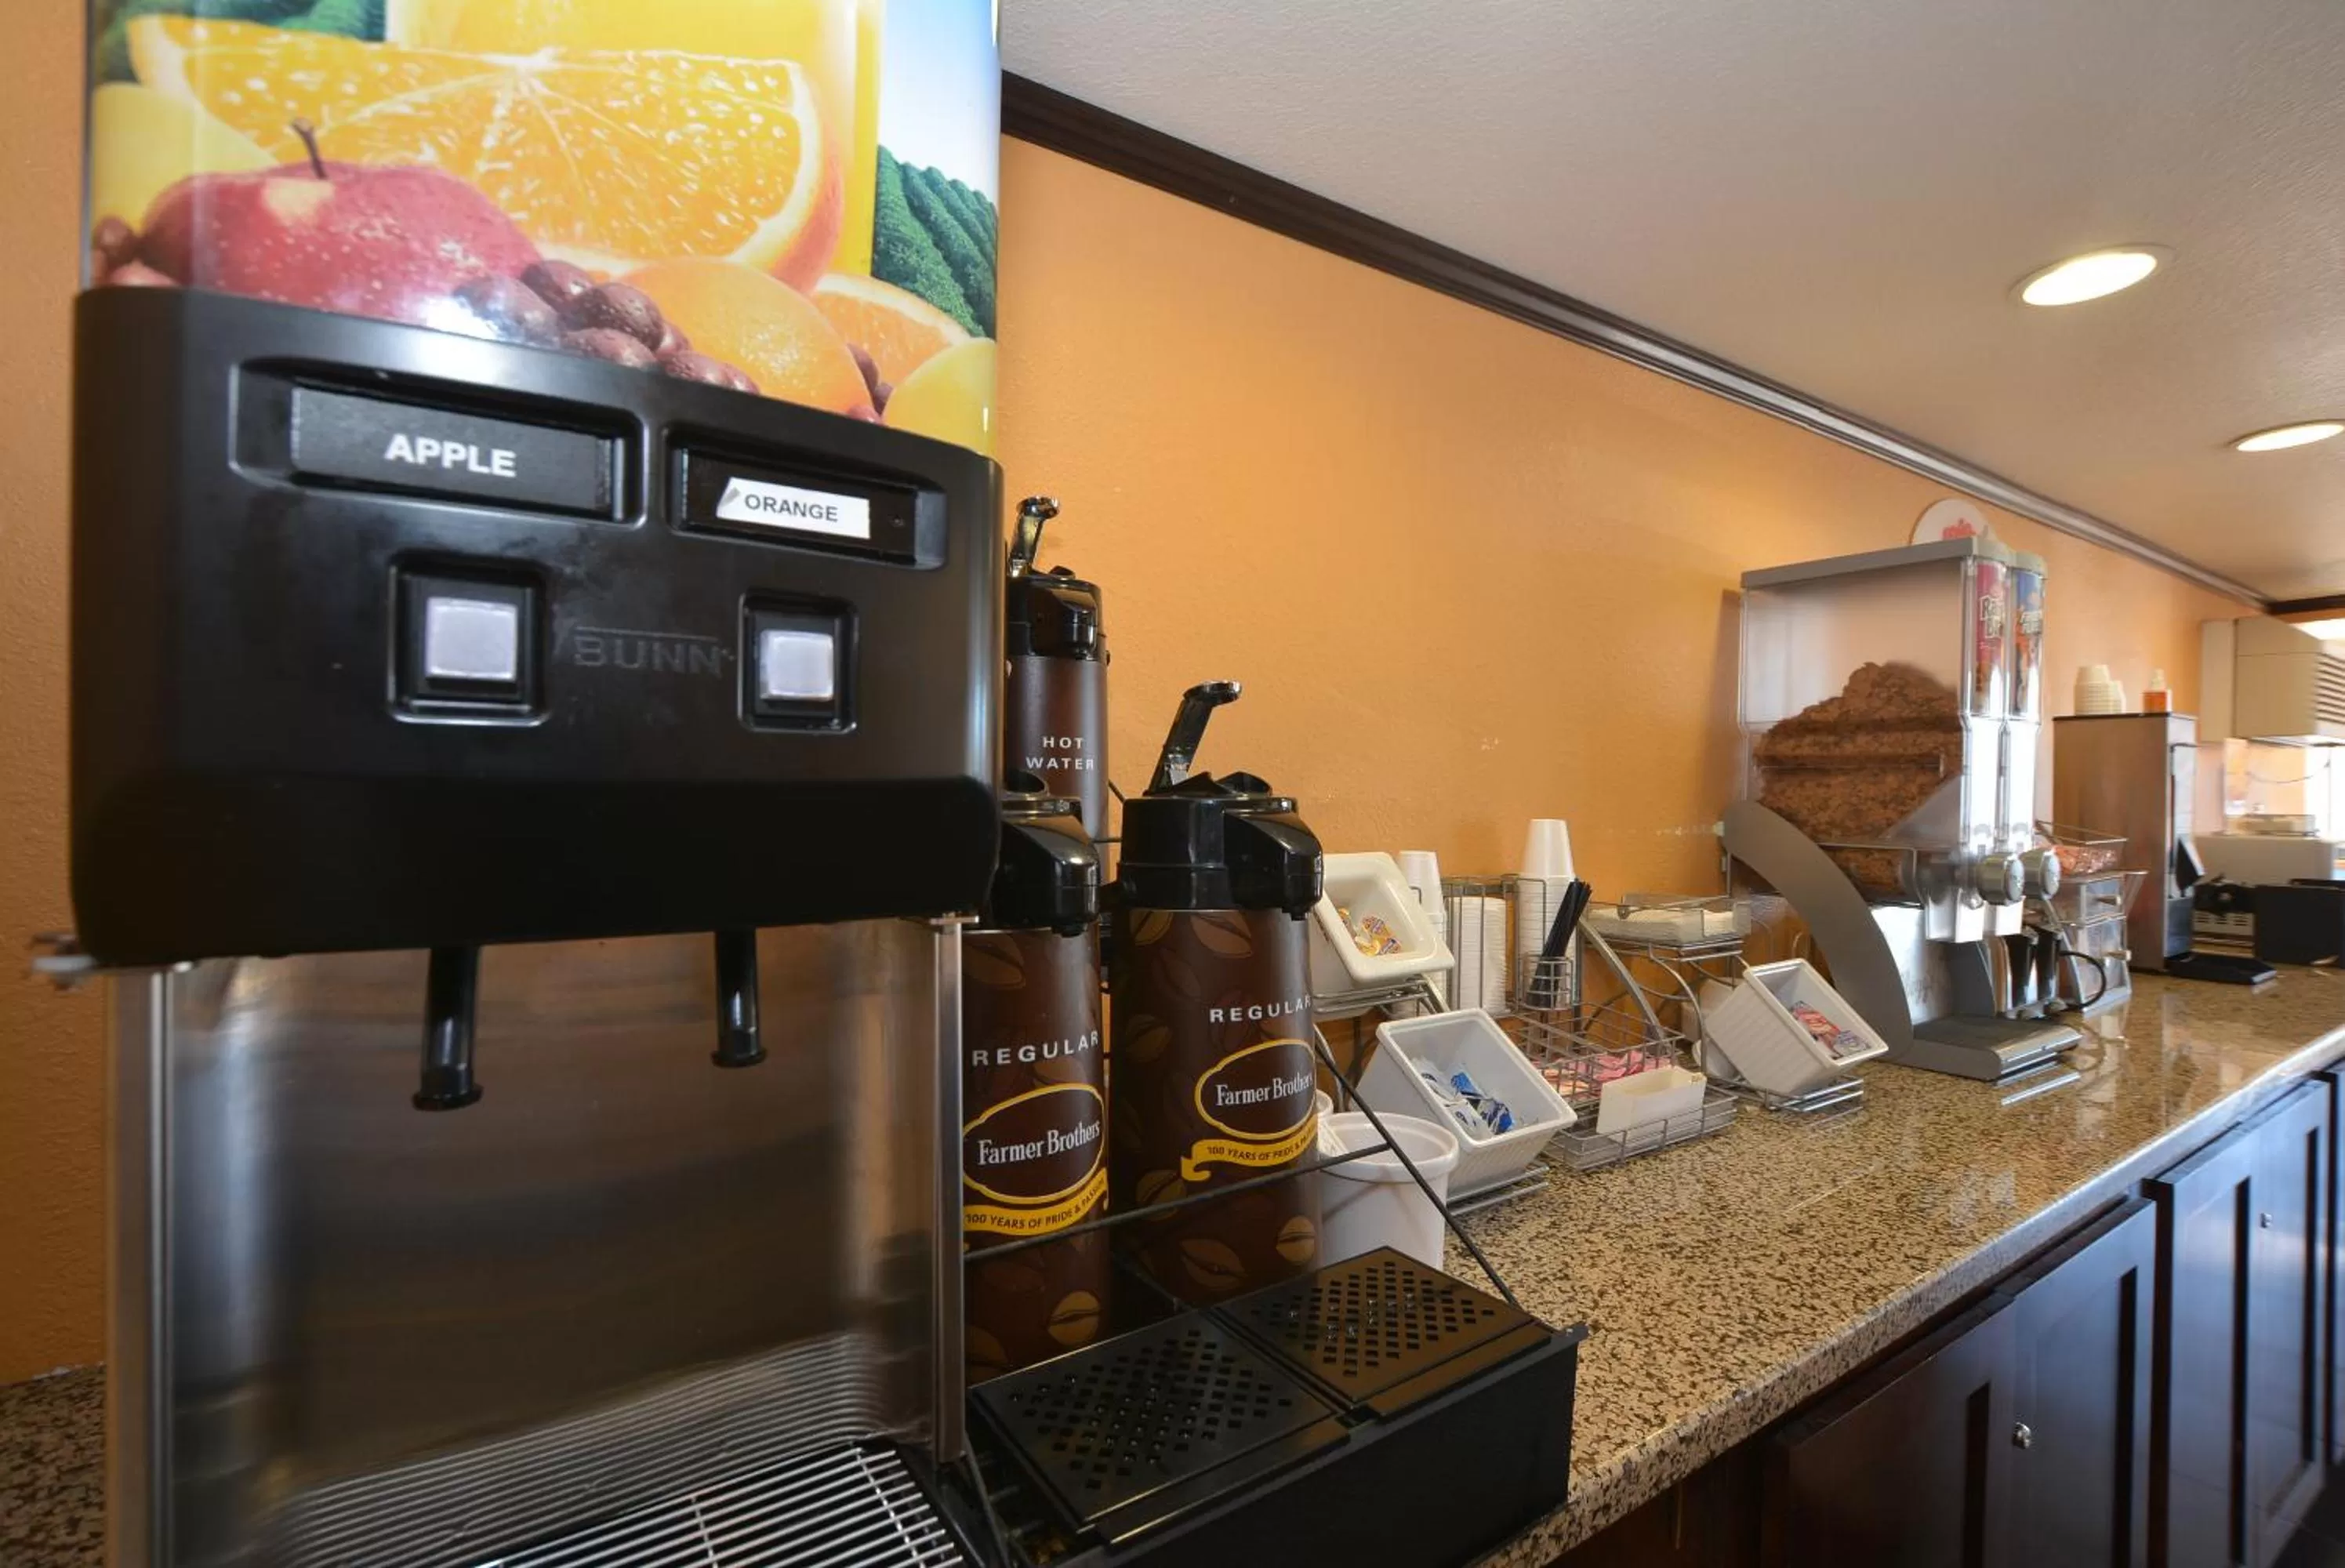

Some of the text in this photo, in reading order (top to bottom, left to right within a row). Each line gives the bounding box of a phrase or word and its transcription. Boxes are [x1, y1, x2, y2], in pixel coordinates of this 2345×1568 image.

[384, 433, 517, 477] APPLE
[744, 493, 839, 523] ORANGE
[573, 635, 722, 678] BUNN
[1042, 736, 1084, 750] HOT
[1025, 757, 1094, 770] WATER
[1210, 994, 1312, 1023] REGULAR
[972, 1030, 1098, 1066] REGULAR
[1215, 1072, 1313, 1106] Farmer Brothers
[977, 1120, 1101, 1166] Farmer Brothers
[1207, 1146, 1225, 1155] 100
[1228, 1148, 1256, 1160] YEARS
[1258, 1152, 1271, 1160] OF
[966, 1214, 988, 1224] 100
[990, 1214, 1025, 1229] YEARS
[1028, 1218, 1042, 1229] OF
[1045, 1210, 1073, 1226] PRIDE
